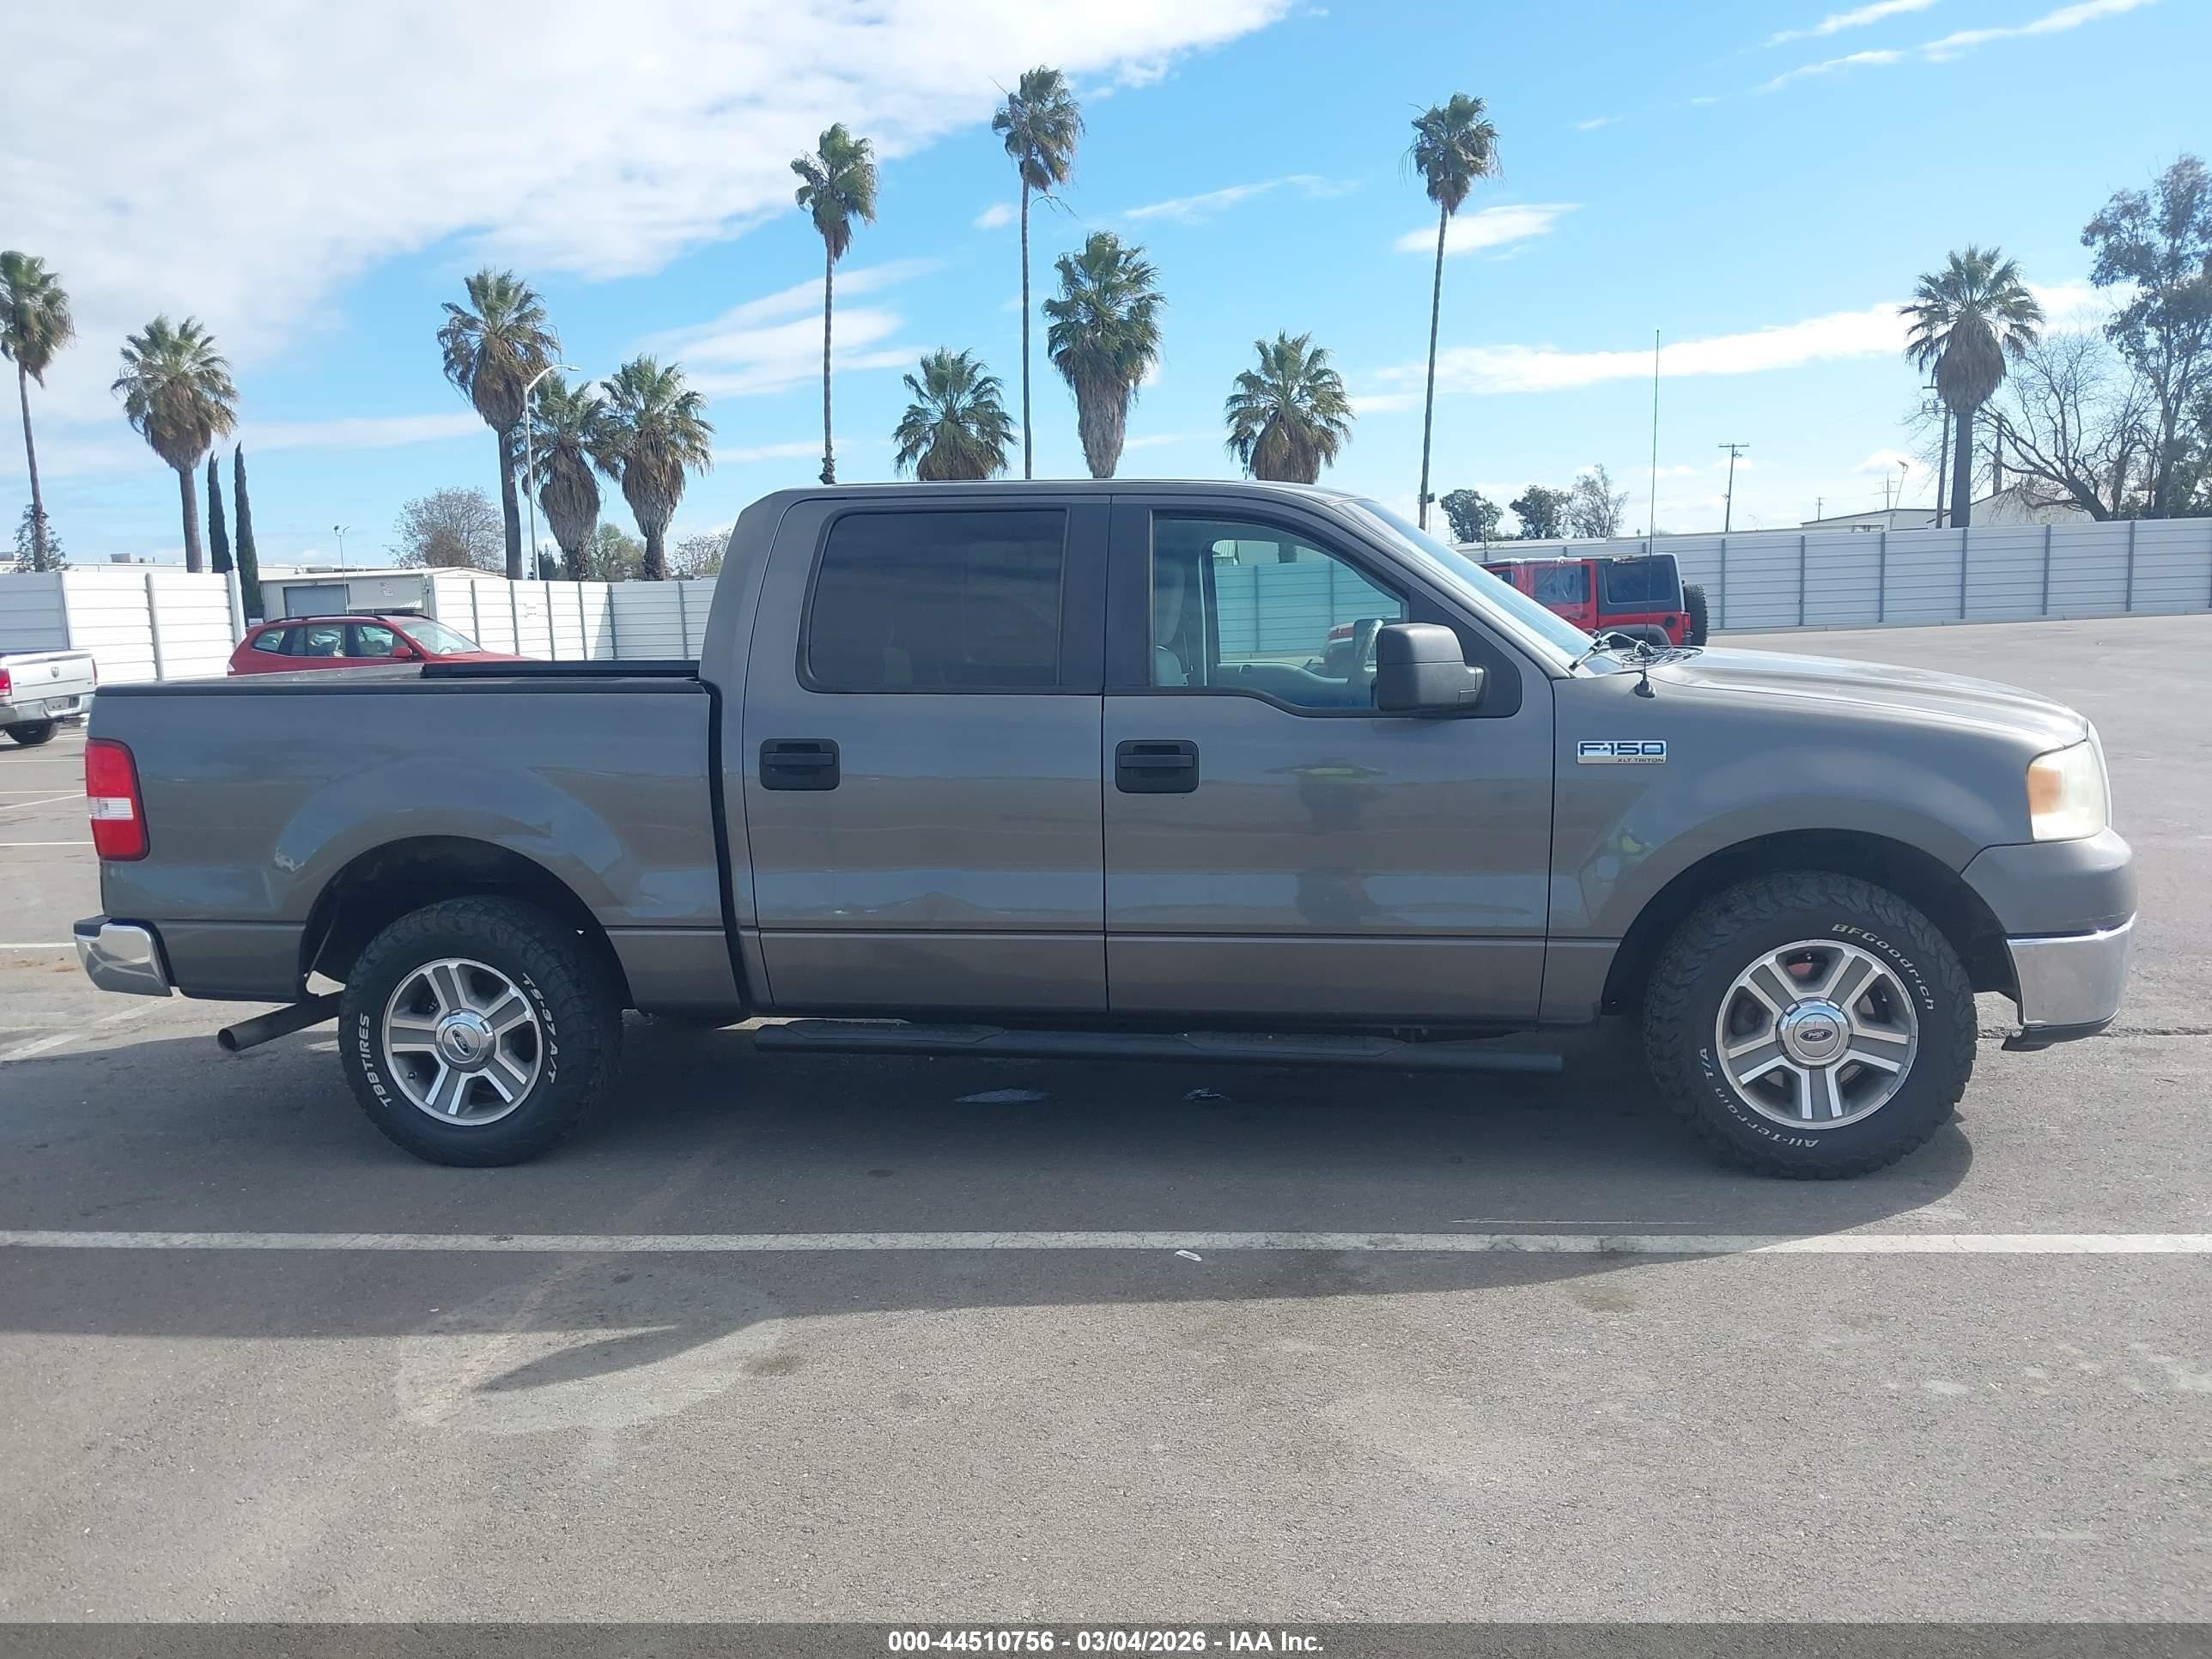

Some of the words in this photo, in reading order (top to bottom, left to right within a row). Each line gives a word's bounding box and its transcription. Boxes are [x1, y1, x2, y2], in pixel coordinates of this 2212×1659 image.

[1579, 742, 1664, 756] F-150
[1831, 923, 1935, 1010] BFGoodrich
[548, 1039, 559, 1084] A/T
[1715, 1087, 1820, 1148] All-Terrain
